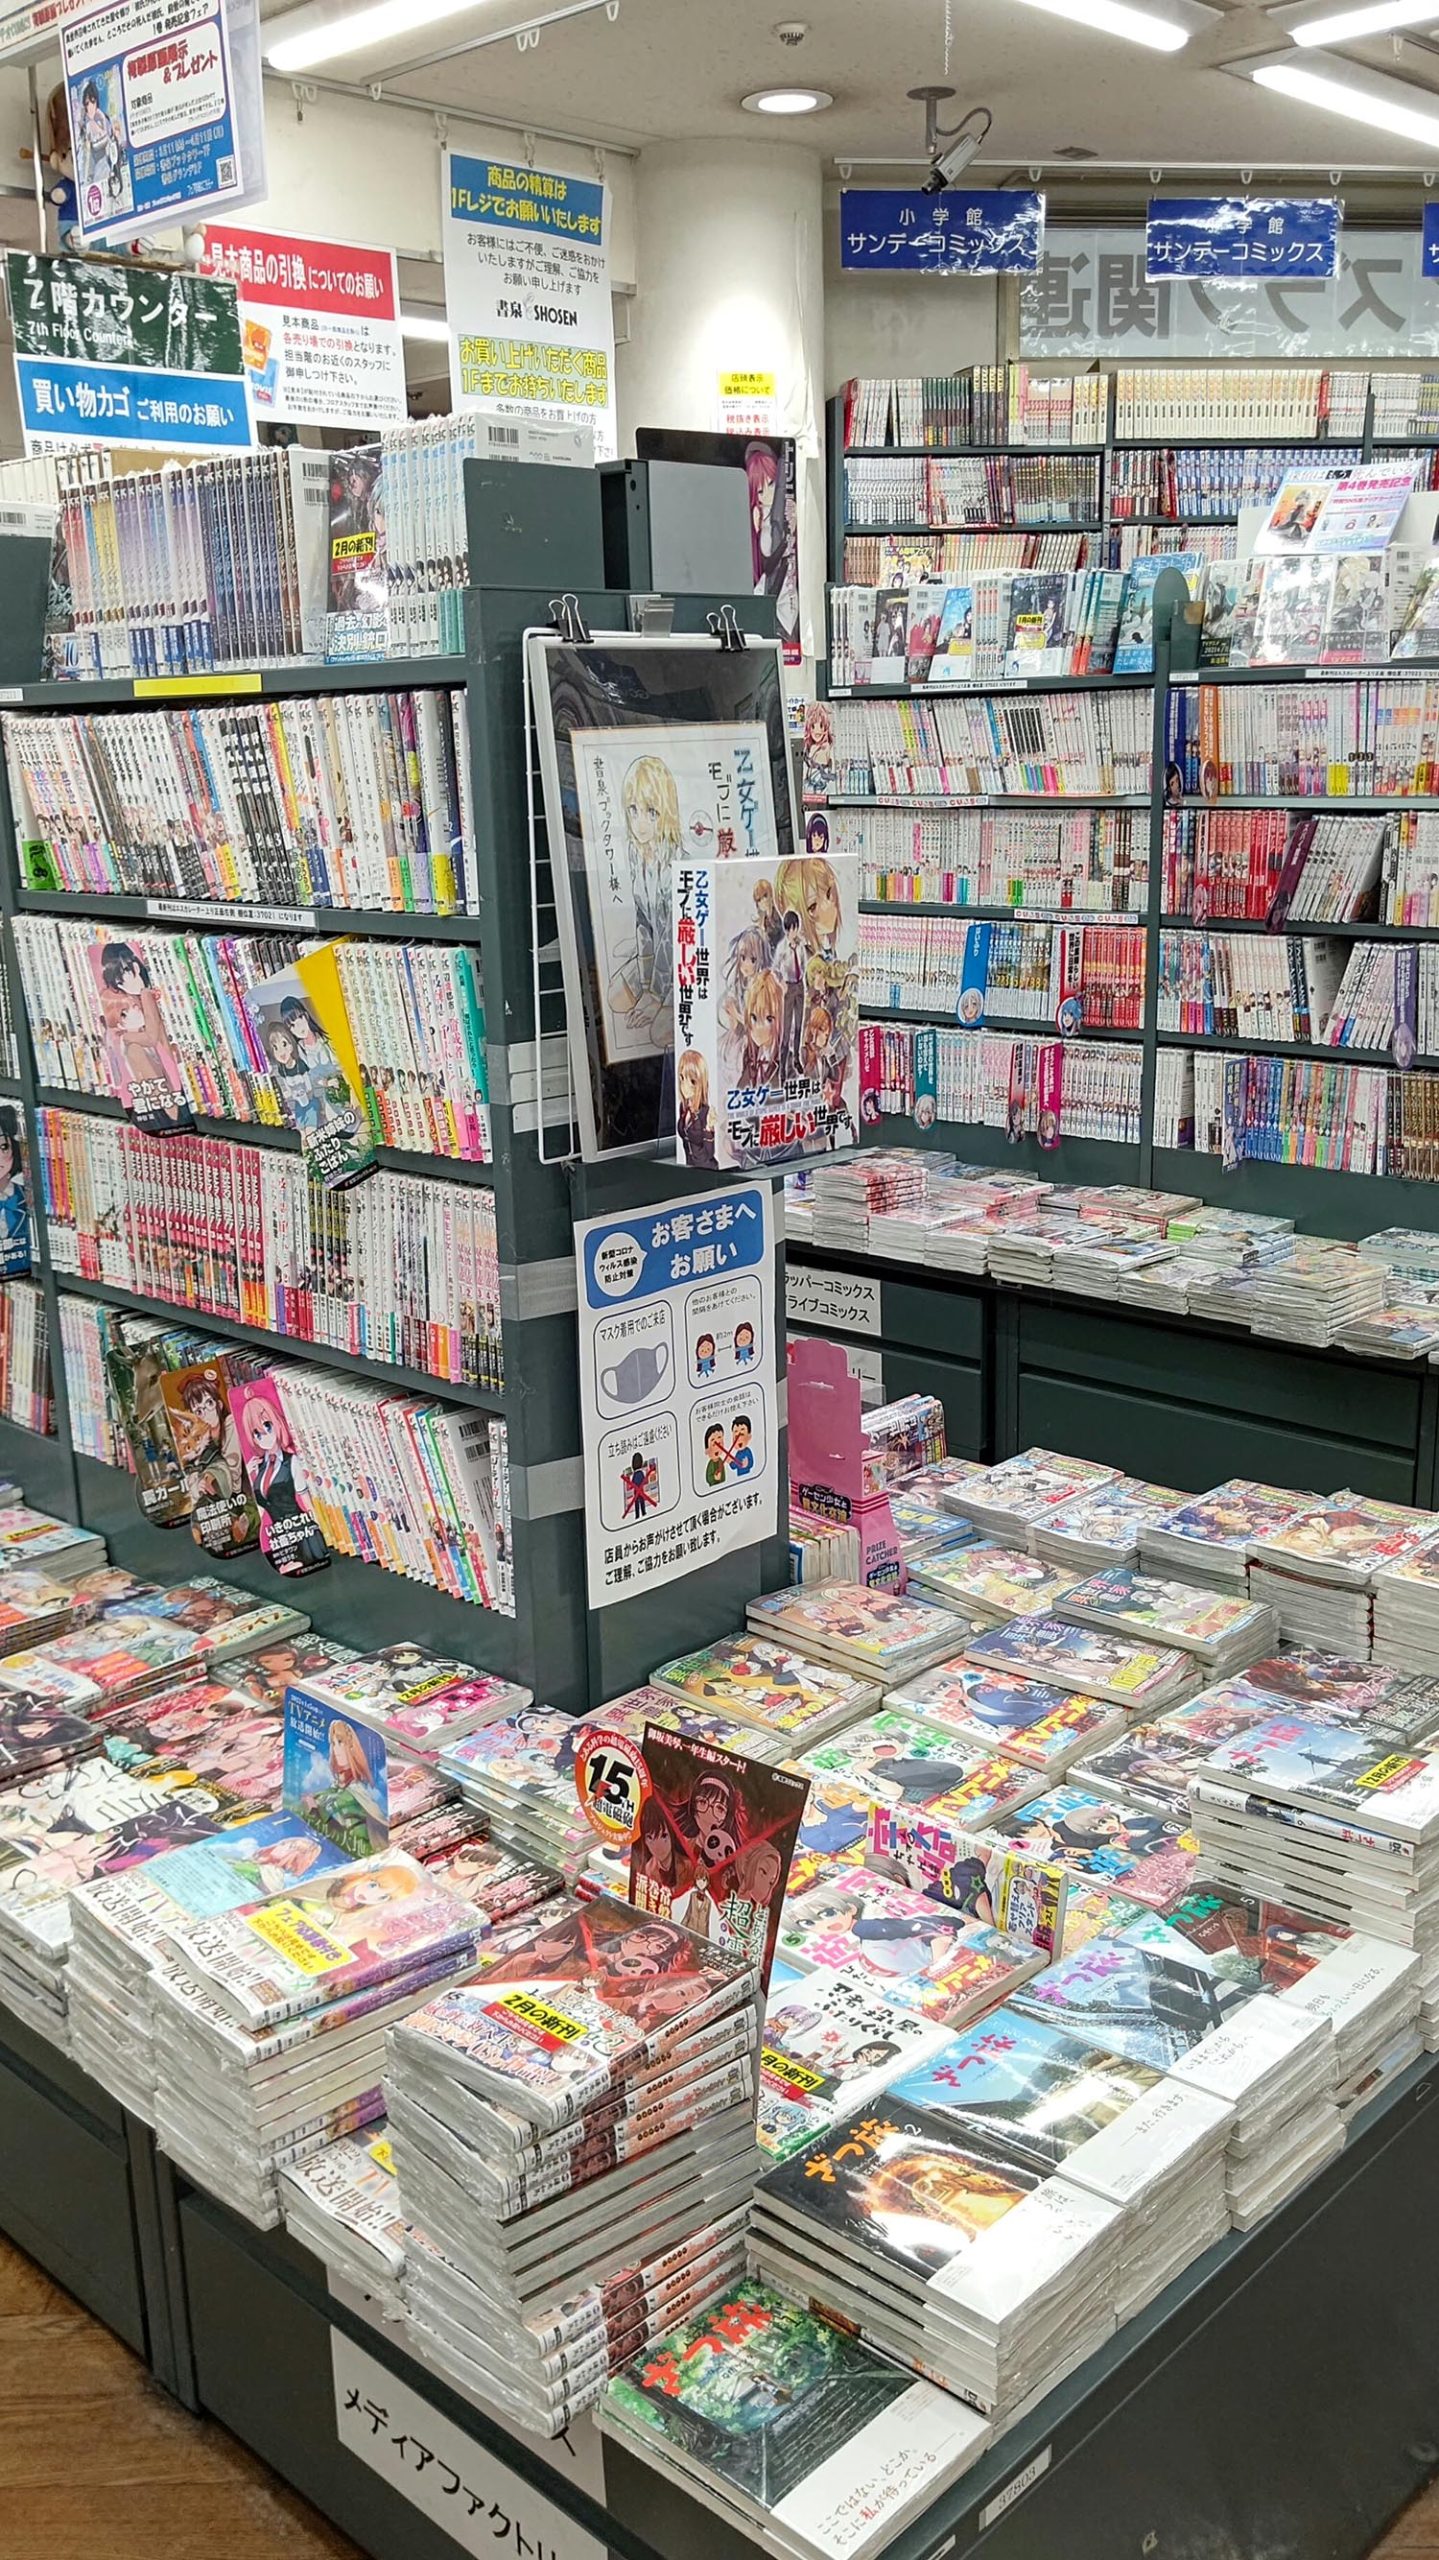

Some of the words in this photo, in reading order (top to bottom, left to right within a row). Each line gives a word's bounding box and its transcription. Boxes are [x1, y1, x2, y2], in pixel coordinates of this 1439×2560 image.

[487, 164, 568, 201] 商品の精算は
[451, 187, 602, 236] 1Fレジでお願いいたします
[899, 207, 984, 227] 小学館
[847, 232, 1038, 257] サンデーコミックス
[1152, 240, 1325, 264] サンデーコミックス
[308, 266, 385, 300] についてのお願い
[503, 272, 582, 296] お願い申し上げます
[23, 277, 219, 328] 7階カウンター
[496, 299, 522, 319] 書泉
[534, 304, 578, 327] SHOSEN
[27, 320, 49, 337] 7th
[282, 315, 320, 331] 見本商品
[283, 332, 397, 357] 各売り場での引換となります。
[460, 336, 608, 380] お買い上げいただく商品
[284, 350, 391, 372] 担当階のお近くのスタッフに
[461, 368, 608, 407] 1Fまでお持ちいたします
[32, 378, 131, 418] 買い物カゴ
[137, 399, 236, 428] ご利用のお願い
[694, 870, 710, 1000] 乙女ゲー世界は
[677, 870, 697, 1047] モブに厳しい世界です
[128, 1078, 168, 1096] やがて
[726, 1077, 822, 1110] 乙女ゲー世界は
[132, 1094, 187, 1114] 君になる
[305, 1111, 356, 1150] 新米姉妹の
[726, 1106, 853, 1149] モブに厳しい世界です
[313, 1141, 341, 1163] ふたり
[650, 1202, 757, 1249] お客さまへ
[598, 1256, 638, 1273] ウィルス感染
[600, 1245, 634, 1261] 新型コロナ
[669, 1242, 738, 1280] お願い
[604, 1270, 634, 1284] 防止対策
[691, 1286, 738, 1307] 他のお客様との
[691, 1293, 757, 1316] 間隔をあけてください。
[599, 1308, 666, 1342] マスク着用でのご来店
[196, 1494, 248, 1518] 魔法使いの
[801, 1485, 848, 1510] ゲーセン少女と
[200, 1515, 233, 1536] 印刷所
[264, 1513, 316, 1537] いきのこれ!
[269, 1526, 317, 1551] 社畜ちゃん
[603, 1491, 764, 1565] 店員からお声がけさせて頂く場合がございます。
[604, 1528, 721, 1586] ご理解、ご協力をお願い致します。
[865, 1548, 898, 1566] CATCHER
[866, 1540, 887, 1556] PRIZE
[288, 1701, 325, 1728] TVアニメ
[587, 1753, 635, 1805] 15
[503, 1993, 583, 2040] 2月の新刊
[931, 2033, 1018, 2087] ざつ旅
[803, 2117, 900, 2183] ざつ旅
[641, 2300, 773, 2397] ざつ旅
[832, 2451, 938, 2546] そこに私が待っている
[998, 2466, 1038, 2512] 37803
